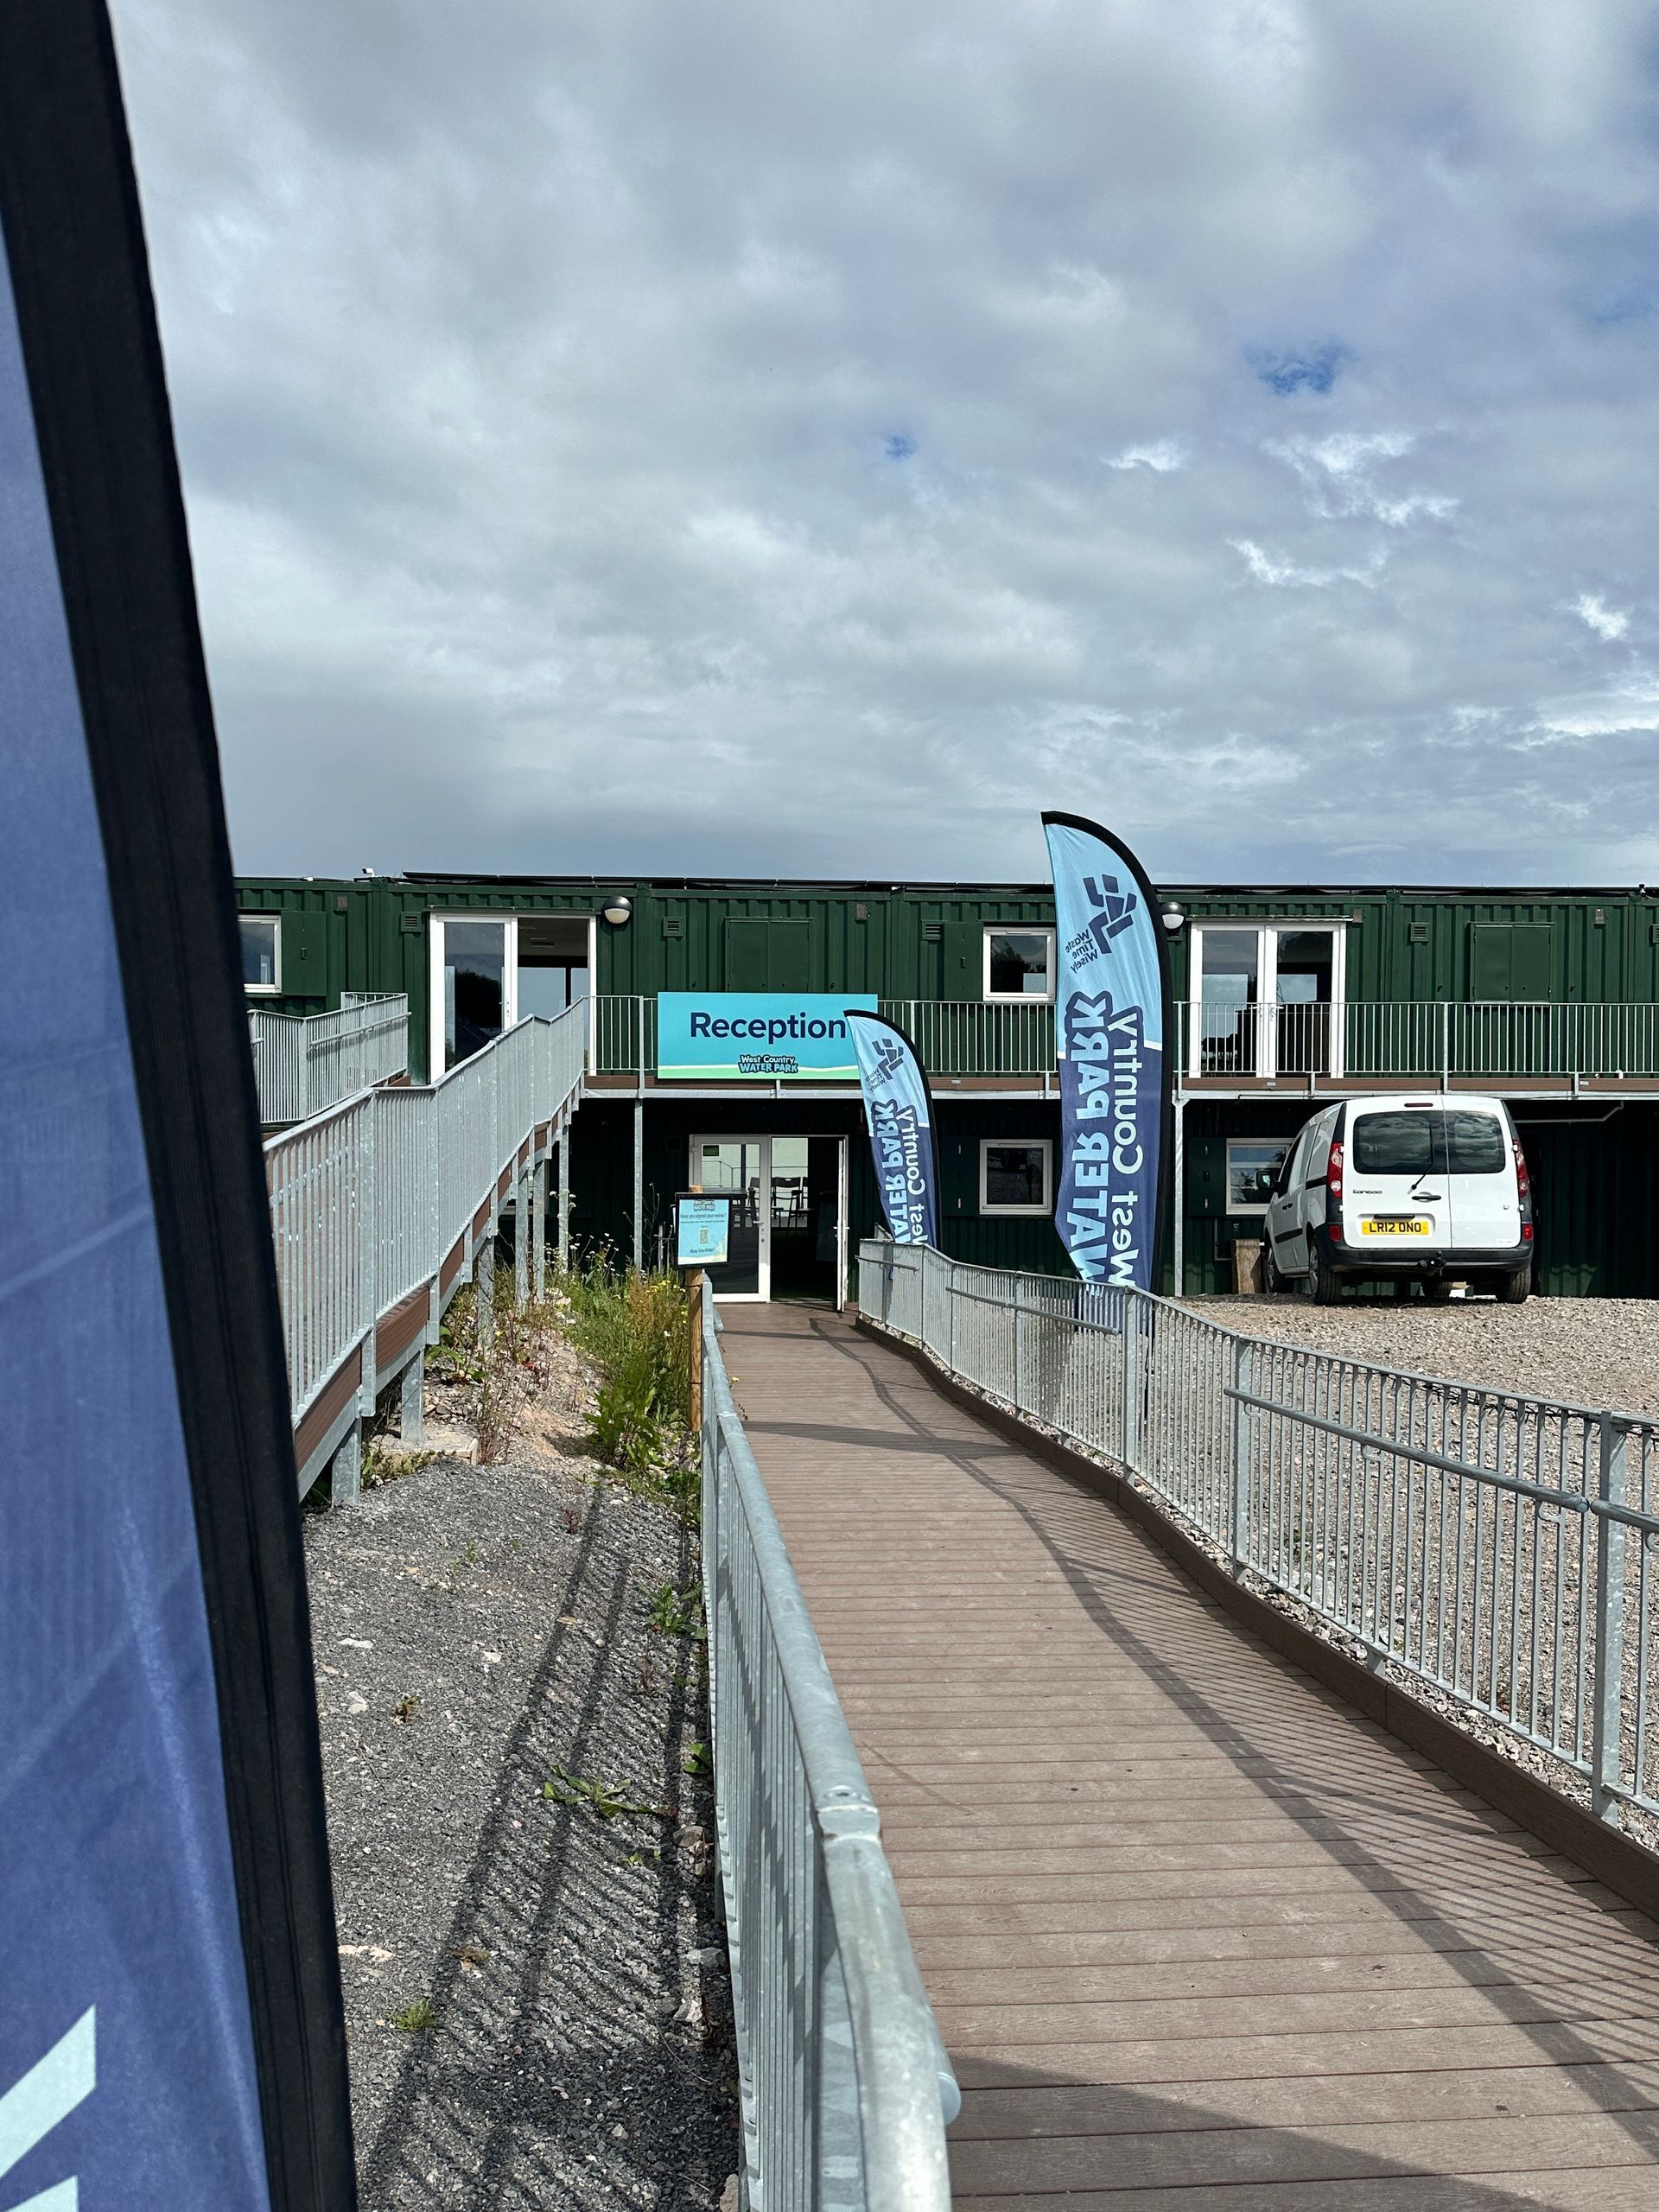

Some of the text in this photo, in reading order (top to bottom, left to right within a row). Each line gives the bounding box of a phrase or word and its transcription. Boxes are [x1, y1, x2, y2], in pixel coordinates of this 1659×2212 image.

[690, 1012, 846, 1045] Reception
[763, 1055, 795, 1065] Country
[739, 1063, 798, 1072] WATER PARK
[1370, 1223, 1395, 1232] LR12
